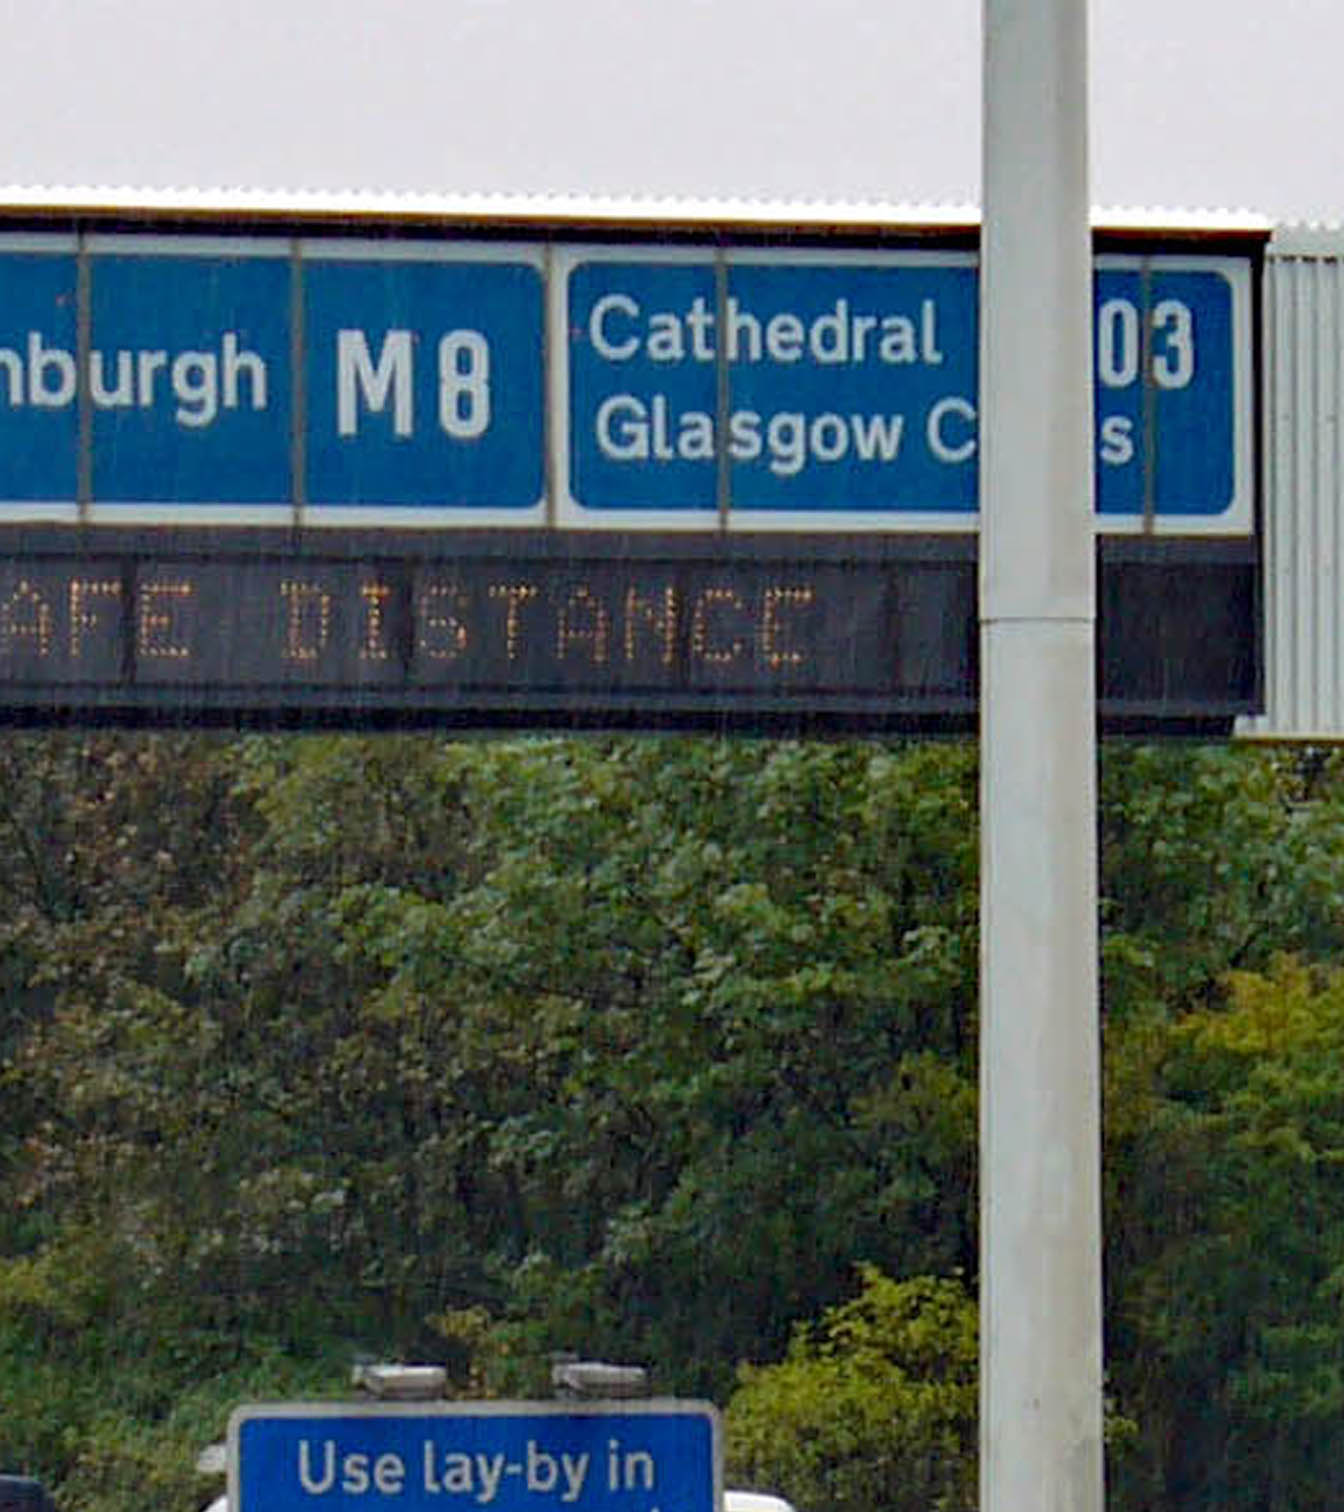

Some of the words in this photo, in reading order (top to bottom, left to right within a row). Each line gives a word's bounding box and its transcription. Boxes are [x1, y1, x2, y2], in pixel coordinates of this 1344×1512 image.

[589, 294, 944, 363] Cathedral
[596, 394, 903, 476] Glasgow
[281, 582, 814, 664] DISTANCE
[298, 1440, 406, 1495] Use
[423, 1440, 589, 1503] lay-by
[608, 1439, 654, 1490] in
